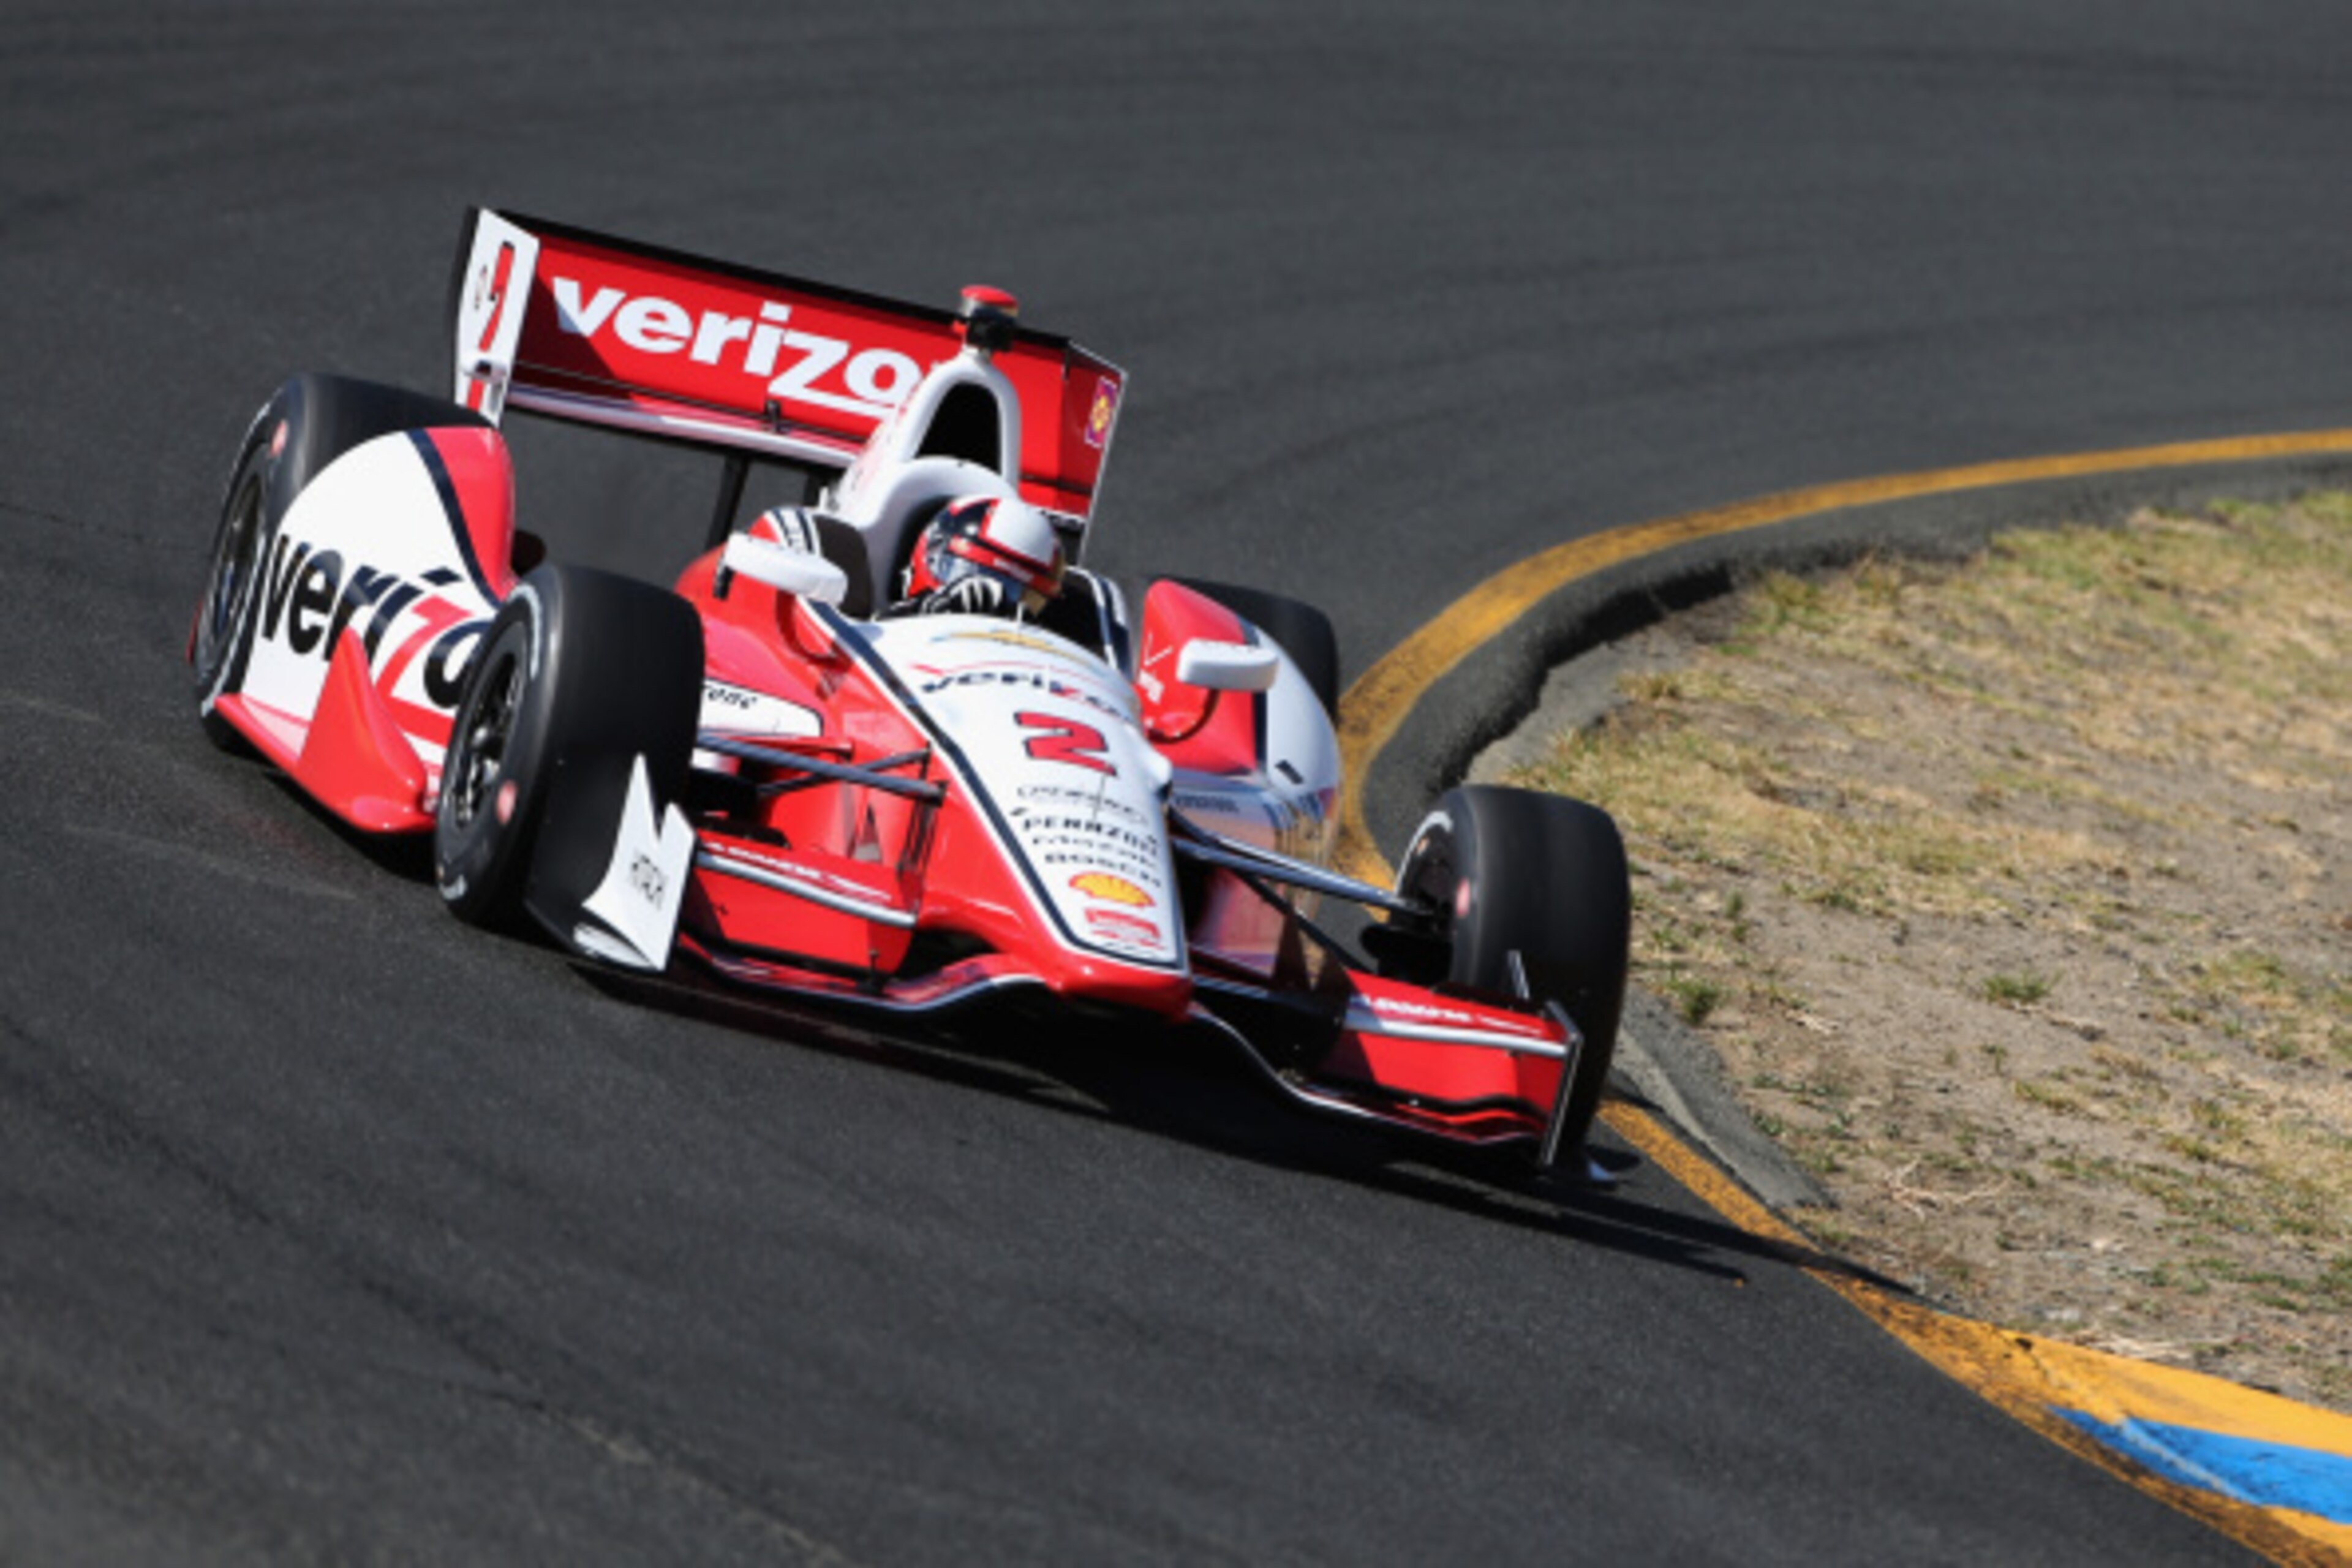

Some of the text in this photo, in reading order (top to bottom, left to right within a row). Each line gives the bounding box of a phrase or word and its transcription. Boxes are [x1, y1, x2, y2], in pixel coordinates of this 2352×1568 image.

[553, 277, 946, 424] verizo
[262, 533, 499, 746] verizo
[1014, 712, 1118, 777] 2
